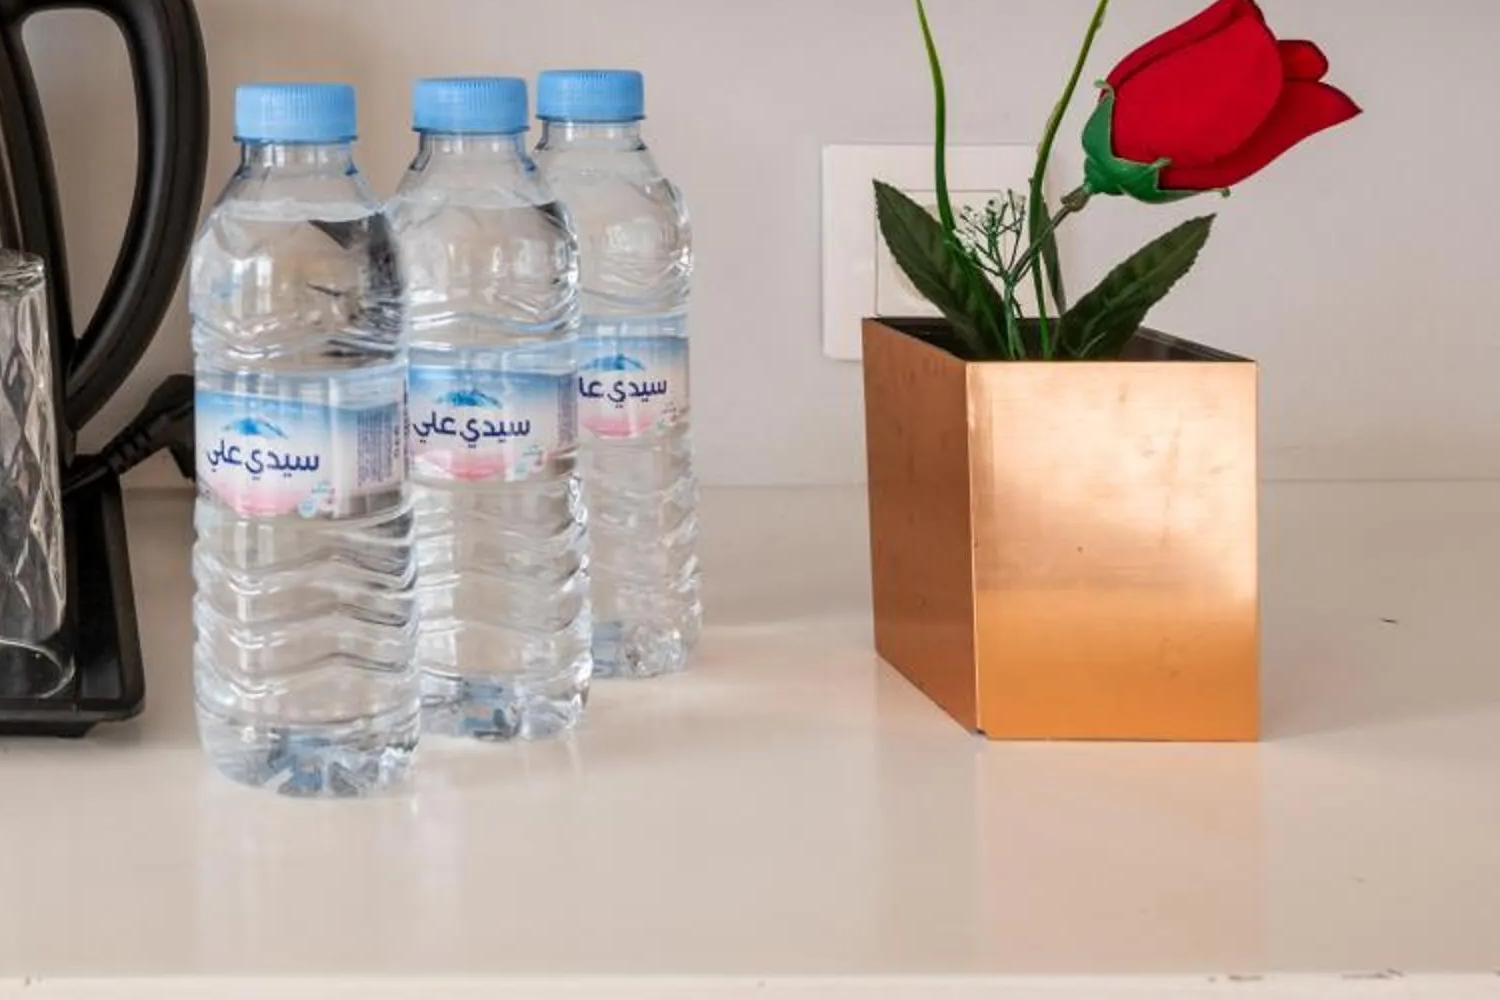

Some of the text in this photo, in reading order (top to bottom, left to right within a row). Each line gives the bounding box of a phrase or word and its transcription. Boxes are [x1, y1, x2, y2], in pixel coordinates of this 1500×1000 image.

[607, 380, 667, 408] سيدي
[412, 411, 456, 444] علي
[460, 418, 530, 448] سيدي
[206, 439, 320, 480] سيدي علي
